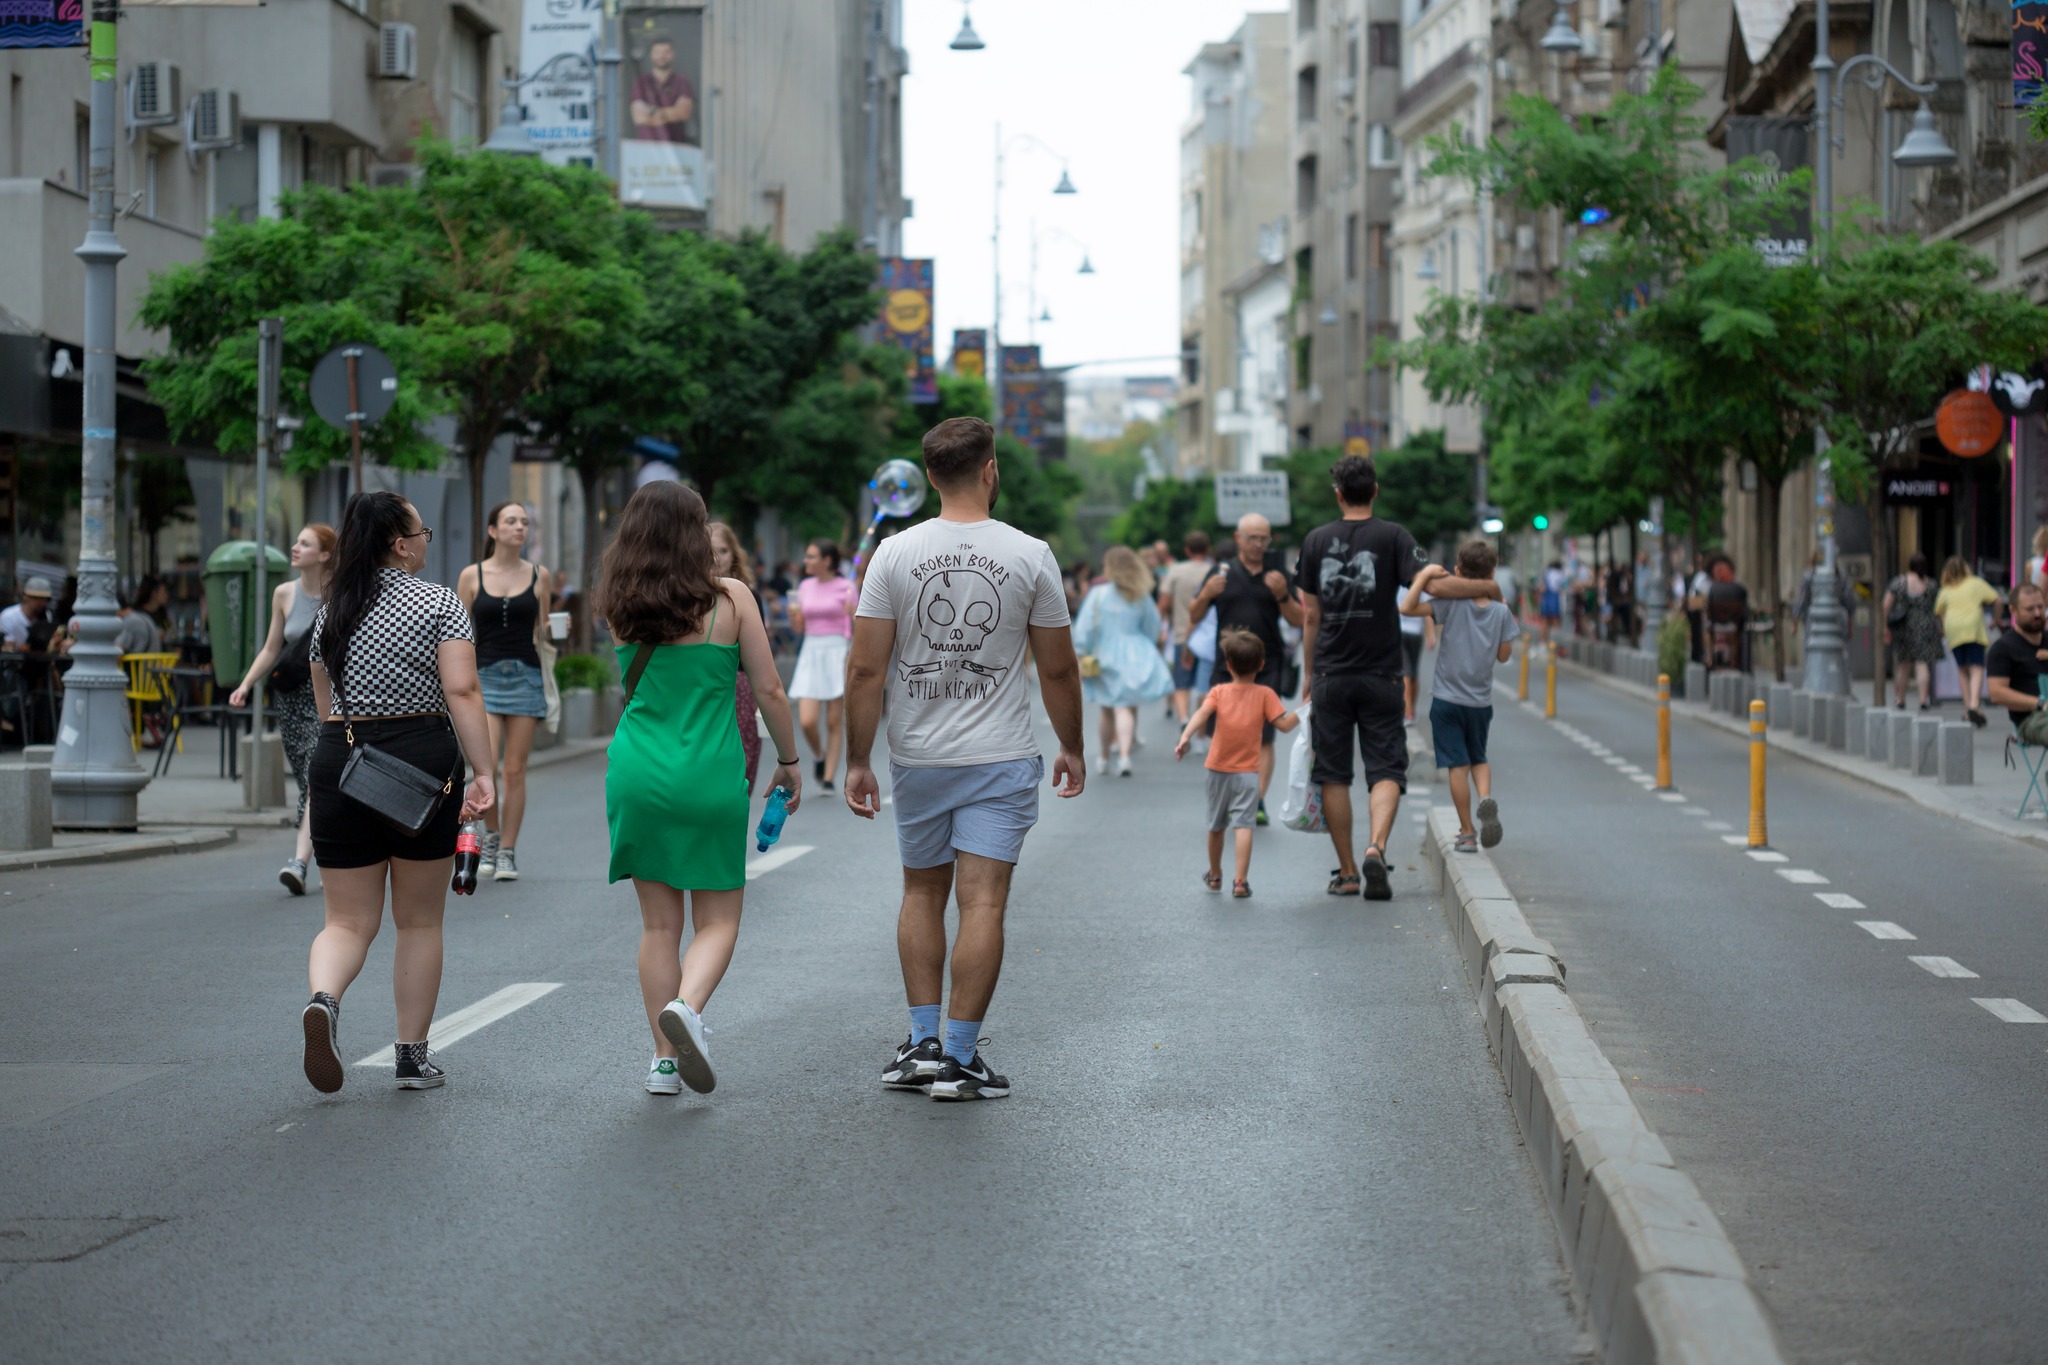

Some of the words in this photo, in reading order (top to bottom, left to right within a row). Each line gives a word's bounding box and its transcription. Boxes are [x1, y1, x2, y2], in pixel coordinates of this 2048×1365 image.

[911, 554, 961, 581] BROKEN
[967, 554, 1010, 586] BONES
[944, 659, 959, 668] BUT
[908, 678, 940, 700] STILL
